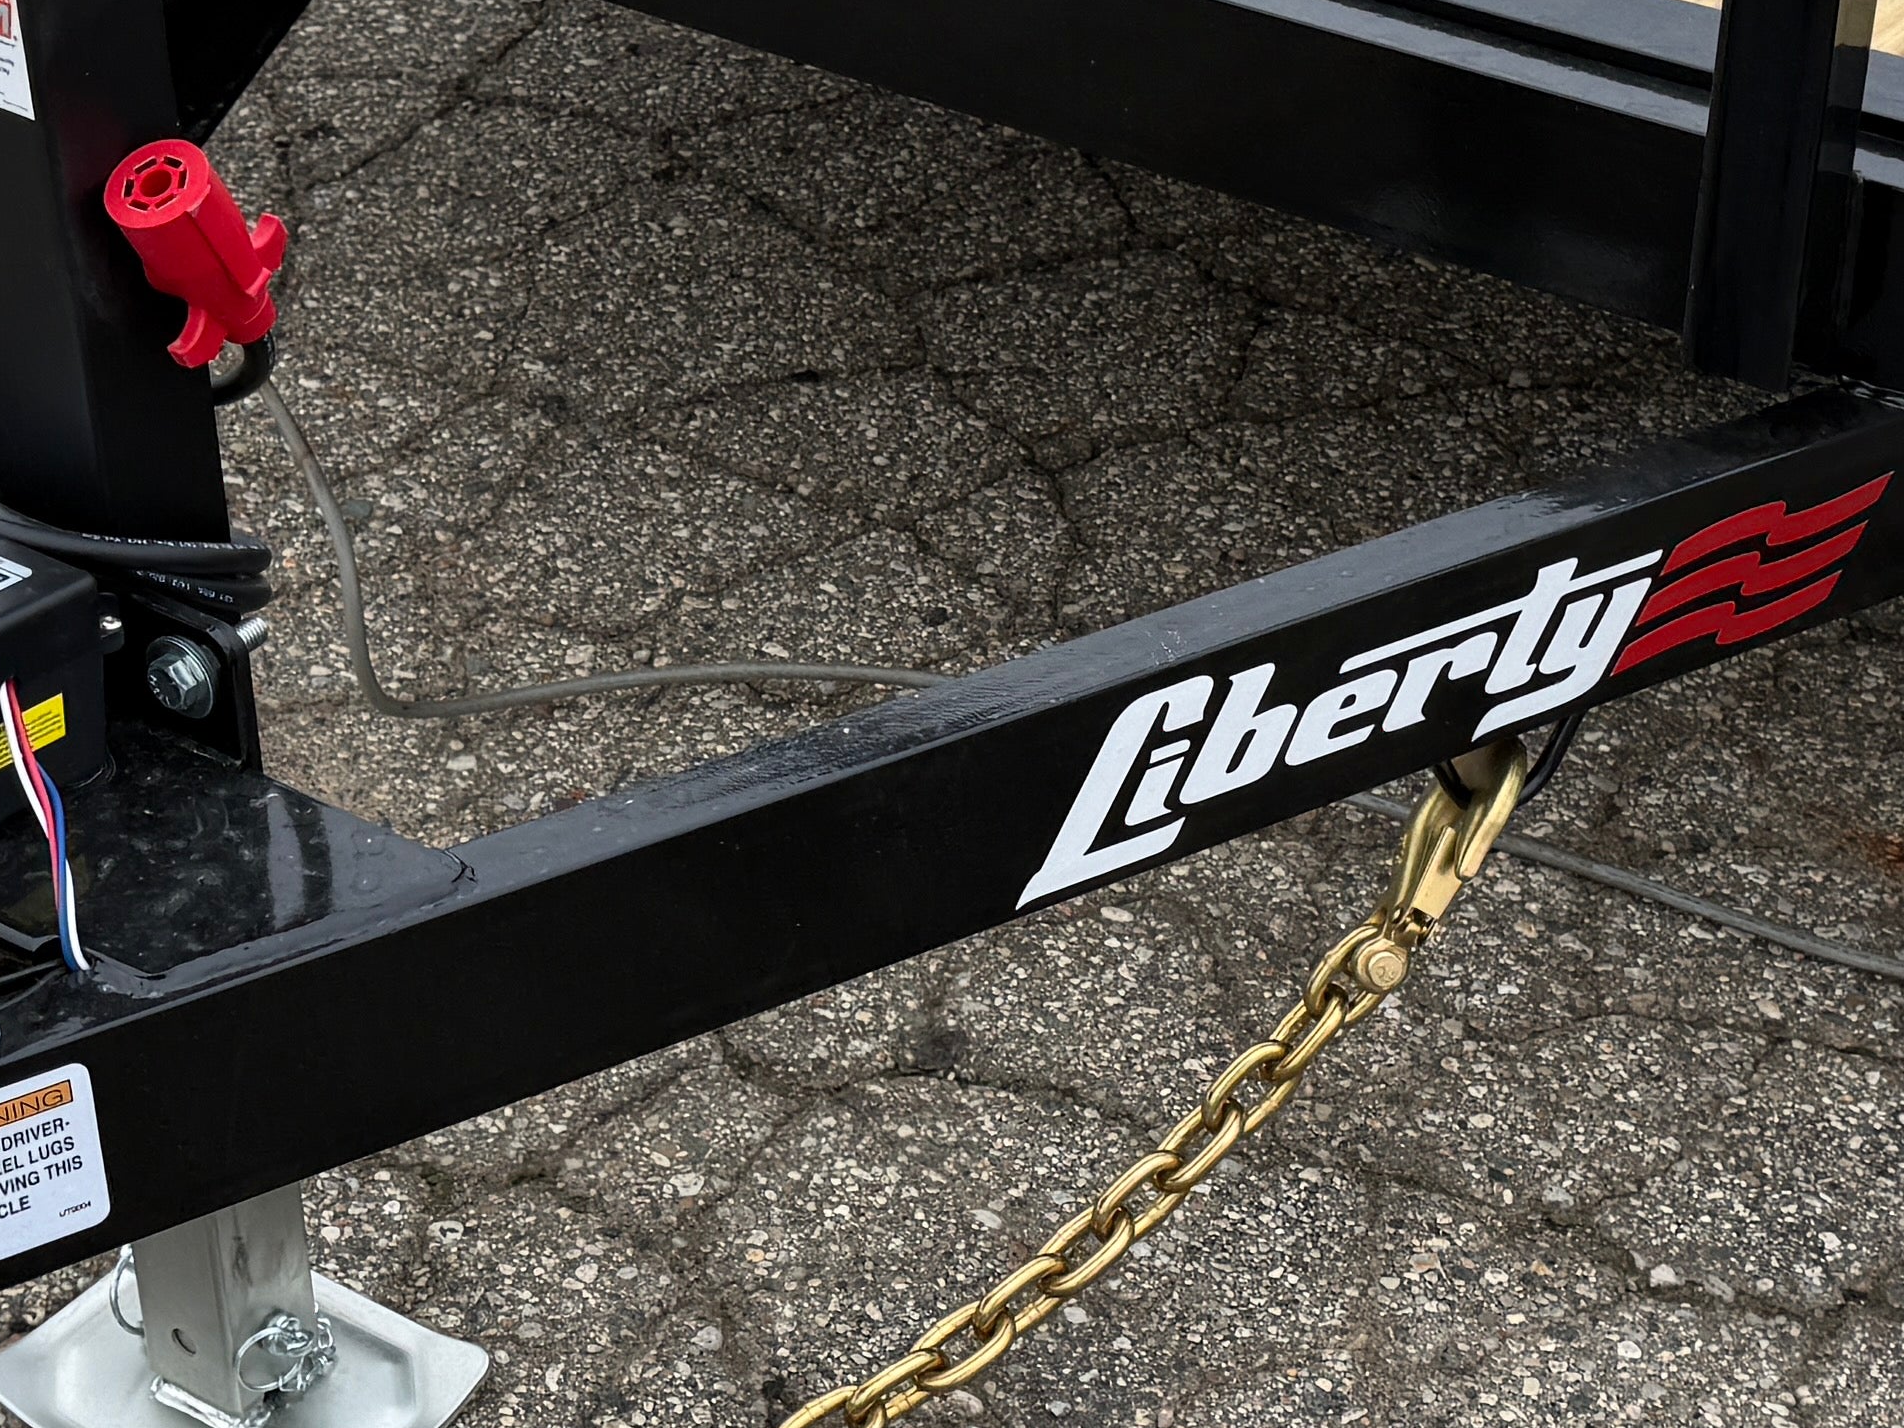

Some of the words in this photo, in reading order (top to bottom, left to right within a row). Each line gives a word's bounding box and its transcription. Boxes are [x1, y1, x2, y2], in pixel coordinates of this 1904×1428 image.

[1017, 548, 1665, 911] Liberty
[27, 1135, 74, 1164] LUGS
[44, 1154, 83, 1180] THIS
